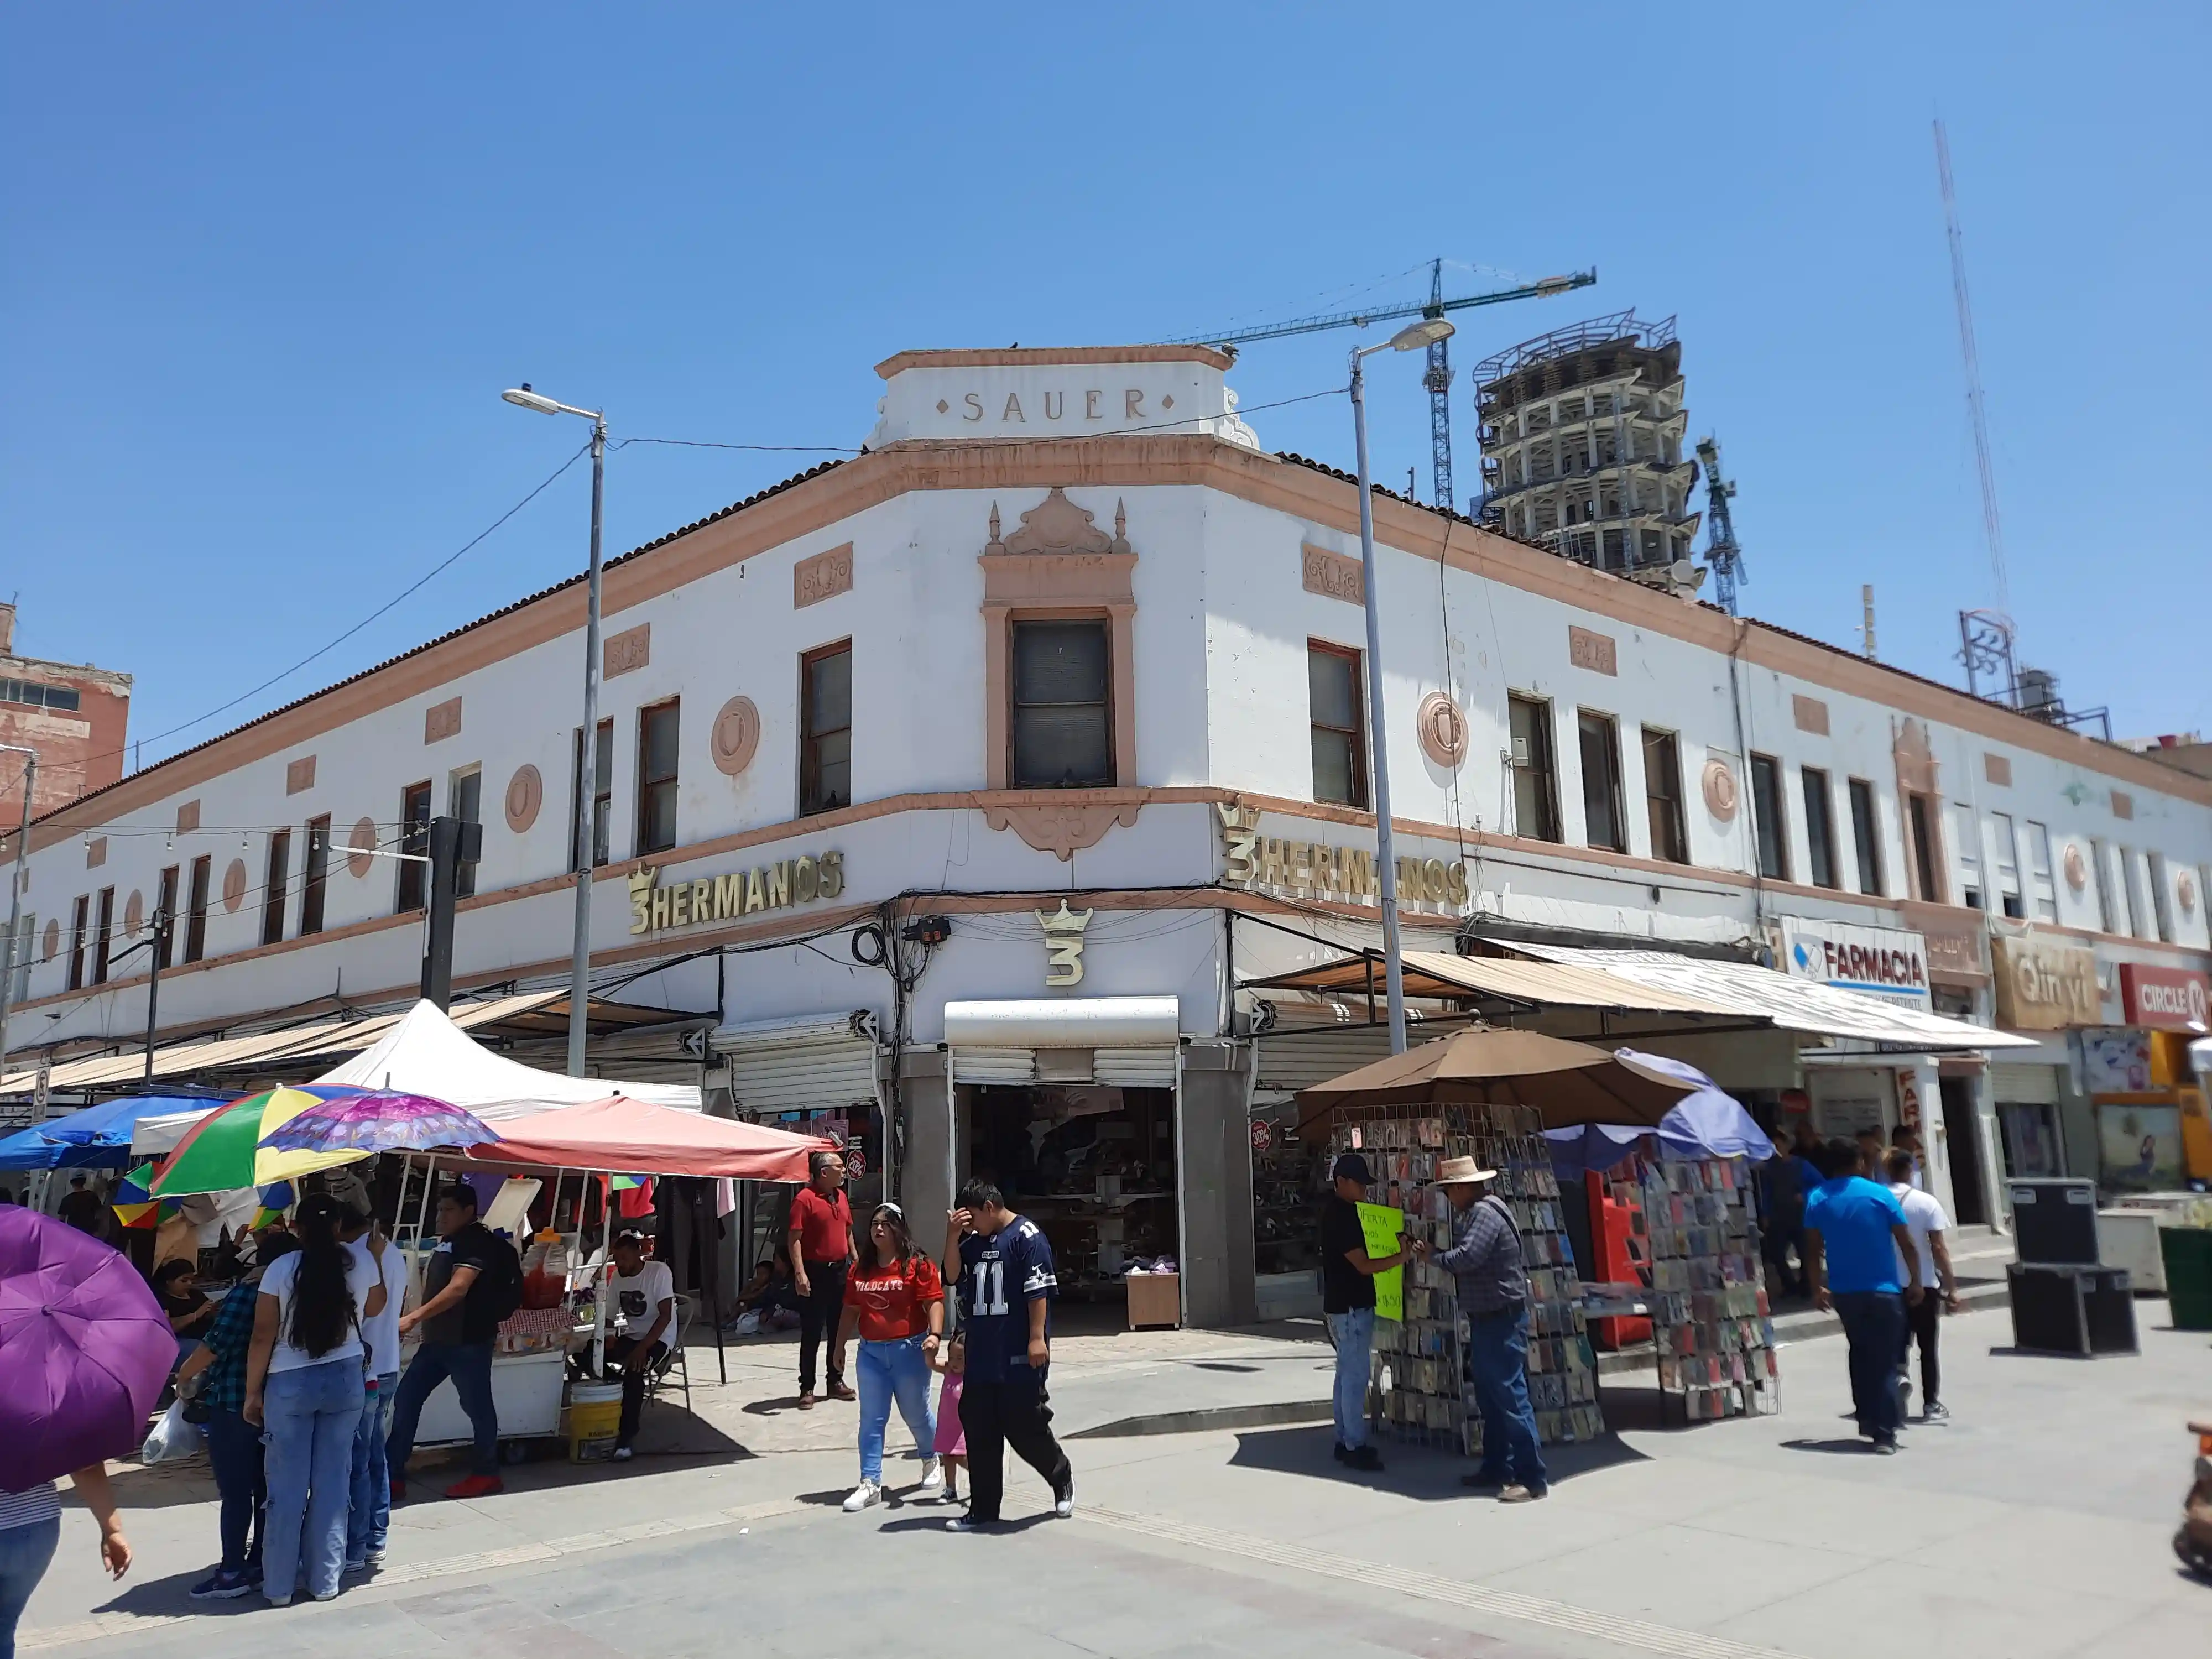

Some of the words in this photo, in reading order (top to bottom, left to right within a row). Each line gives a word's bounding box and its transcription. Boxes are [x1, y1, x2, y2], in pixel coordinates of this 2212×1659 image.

[962, 389, 1146, 422] SAUER
[1223, 830, 1257, 882] 3
[1258, 836, 1470, 907] HERMNOS
[630, 888, 650, 935] 3
[652, 850, 843, 931] HERMANOS
[1046, 937, 1084, 985] 3
[1824, 941, 1927, 987] FARMACIA
[2142, 983, 2188, 1014] CIRCLE
[1252, 1128, 1269, 1145] 30%
[848, 1157, 863, 1176] 20%
[1019, 1221, 1040, 1239] 11
[855, 1280, 904, 1292] WILDCATS
[973, 1261, 1008, 1316] 11
